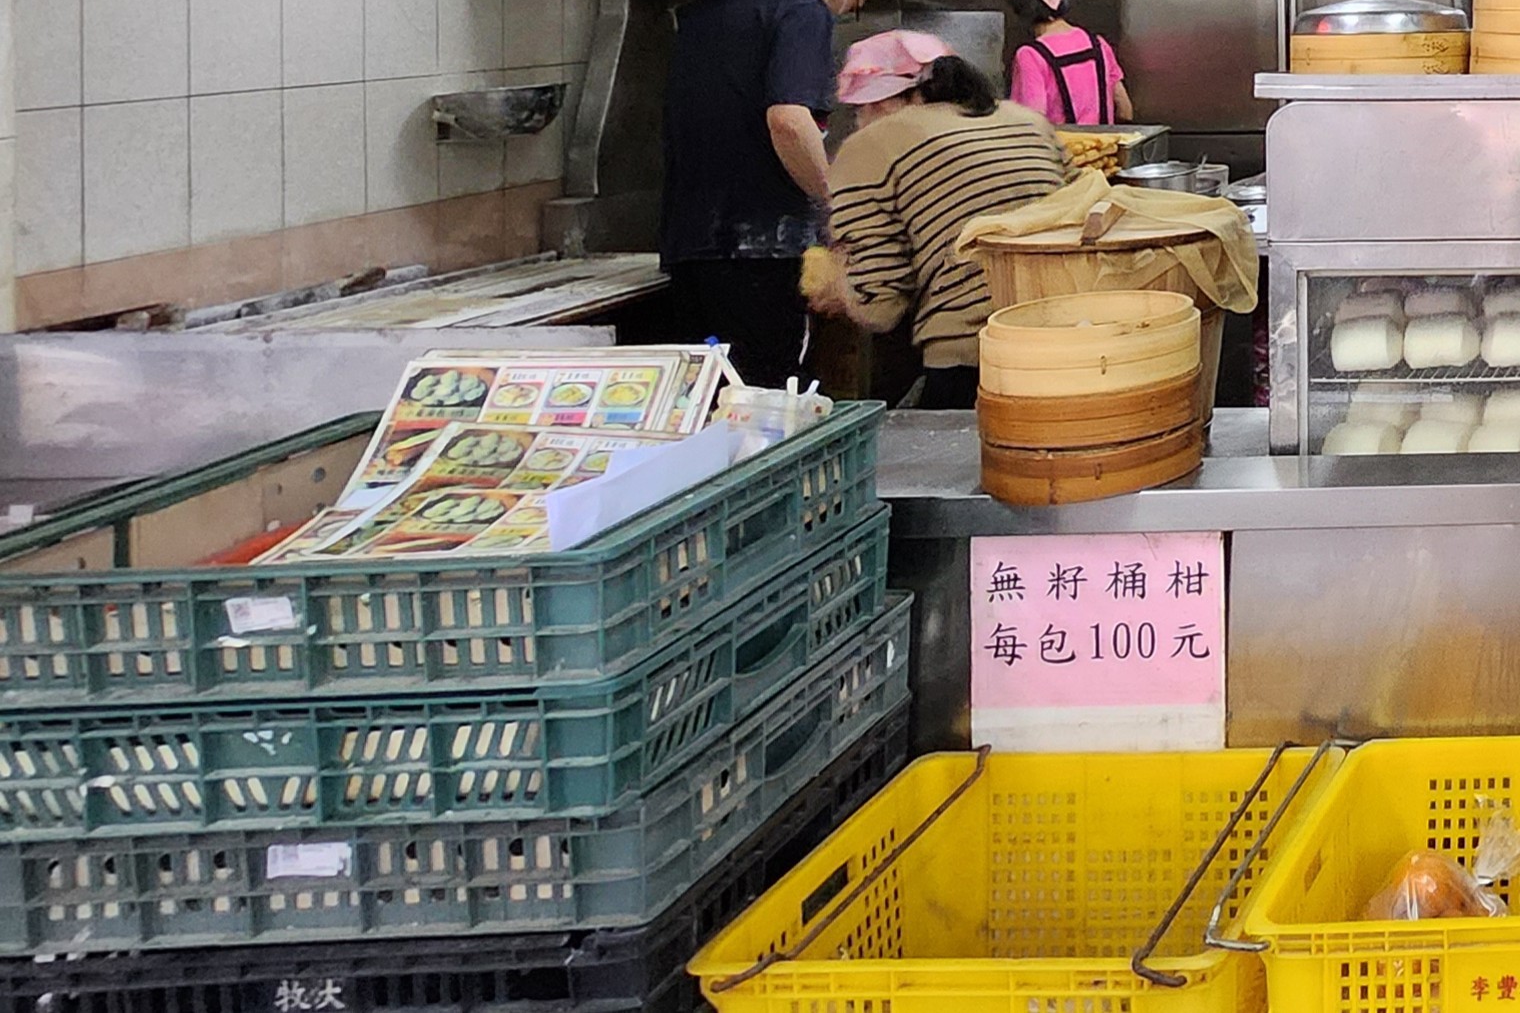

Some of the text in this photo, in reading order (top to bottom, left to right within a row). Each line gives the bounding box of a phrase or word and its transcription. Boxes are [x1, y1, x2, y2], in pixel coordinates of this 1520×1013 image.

[986, 561, 1209, 603] 無籽桶柑
[984, 622, 1210, 666] 每包100元
